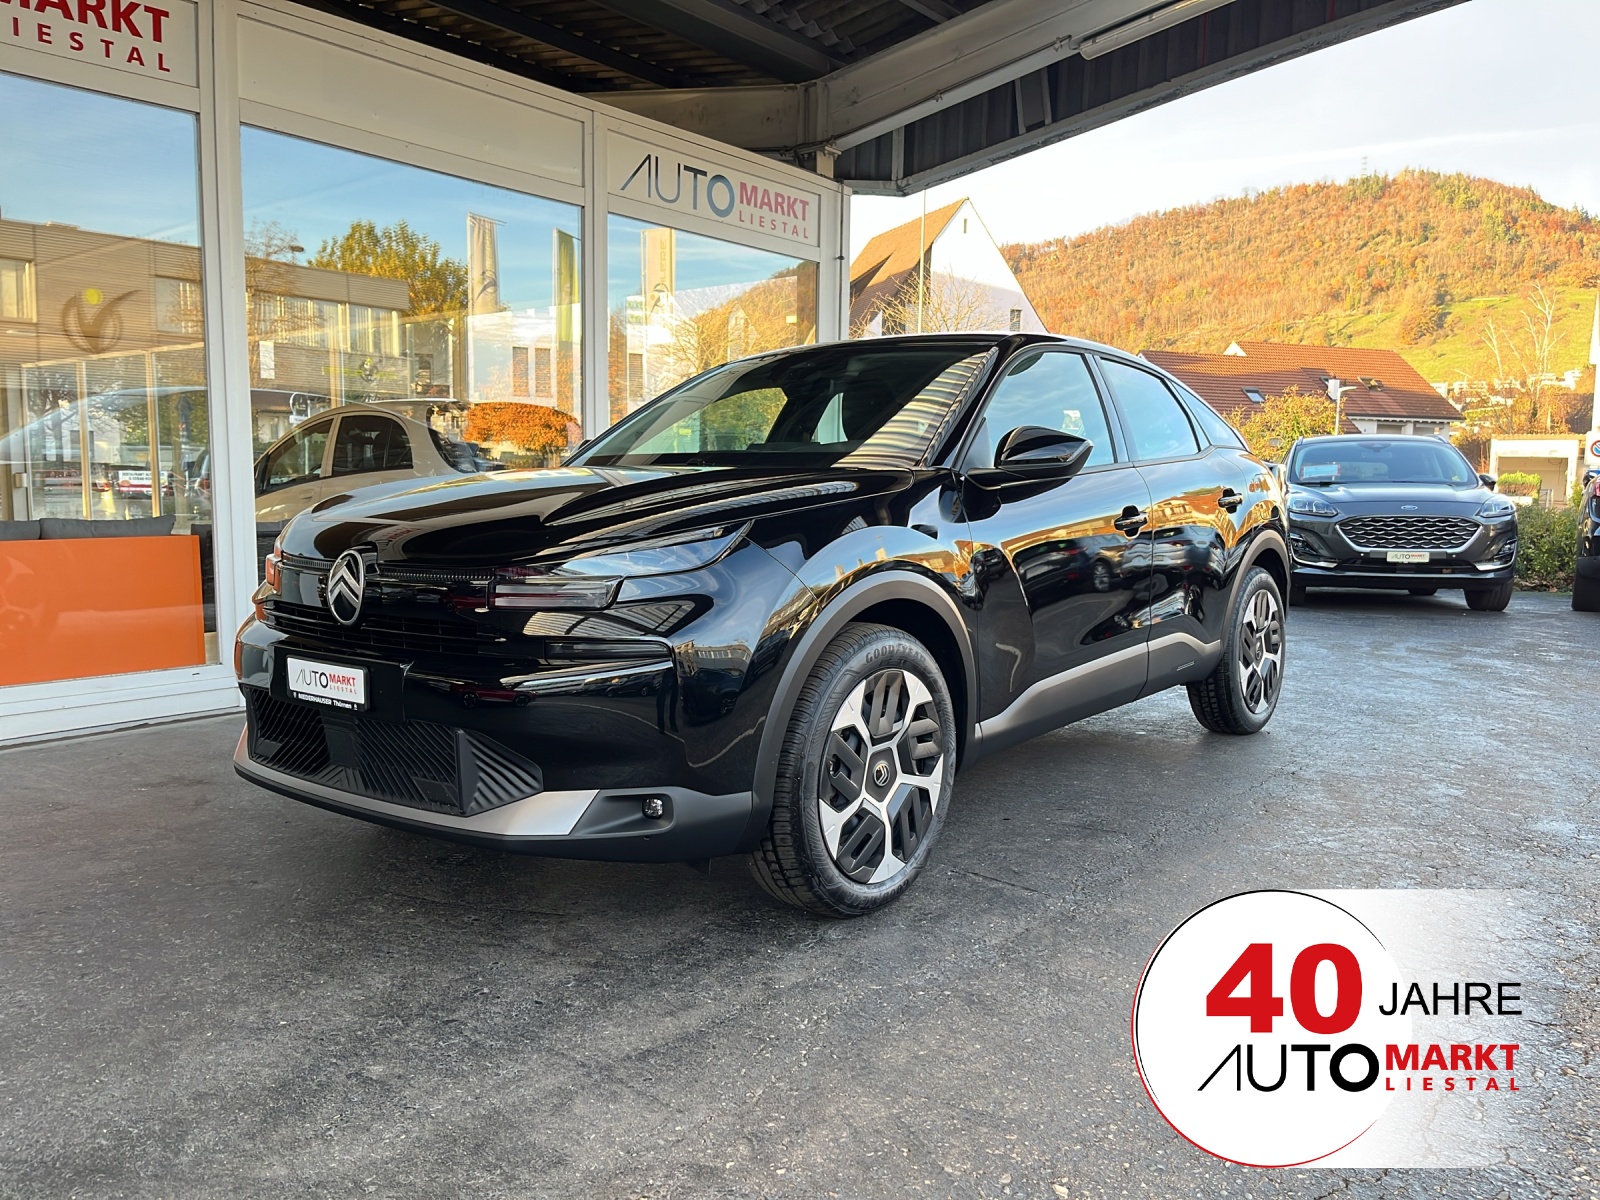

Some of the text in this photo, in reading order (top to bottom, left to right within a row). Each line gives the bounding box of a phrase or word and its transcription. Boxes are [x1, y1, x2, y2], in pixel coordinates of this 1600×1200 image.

[0, 0, 170, 43] ARKT
[12, 16, 171, 73] IESTAL
[620, 153, 810, 222] AUTO MARKT
[738, 210, 809, 239] LIESTAL
[296, 668, 356, 689] AUTO MARKT
[329, 685, 357, 695] LIESTAL
